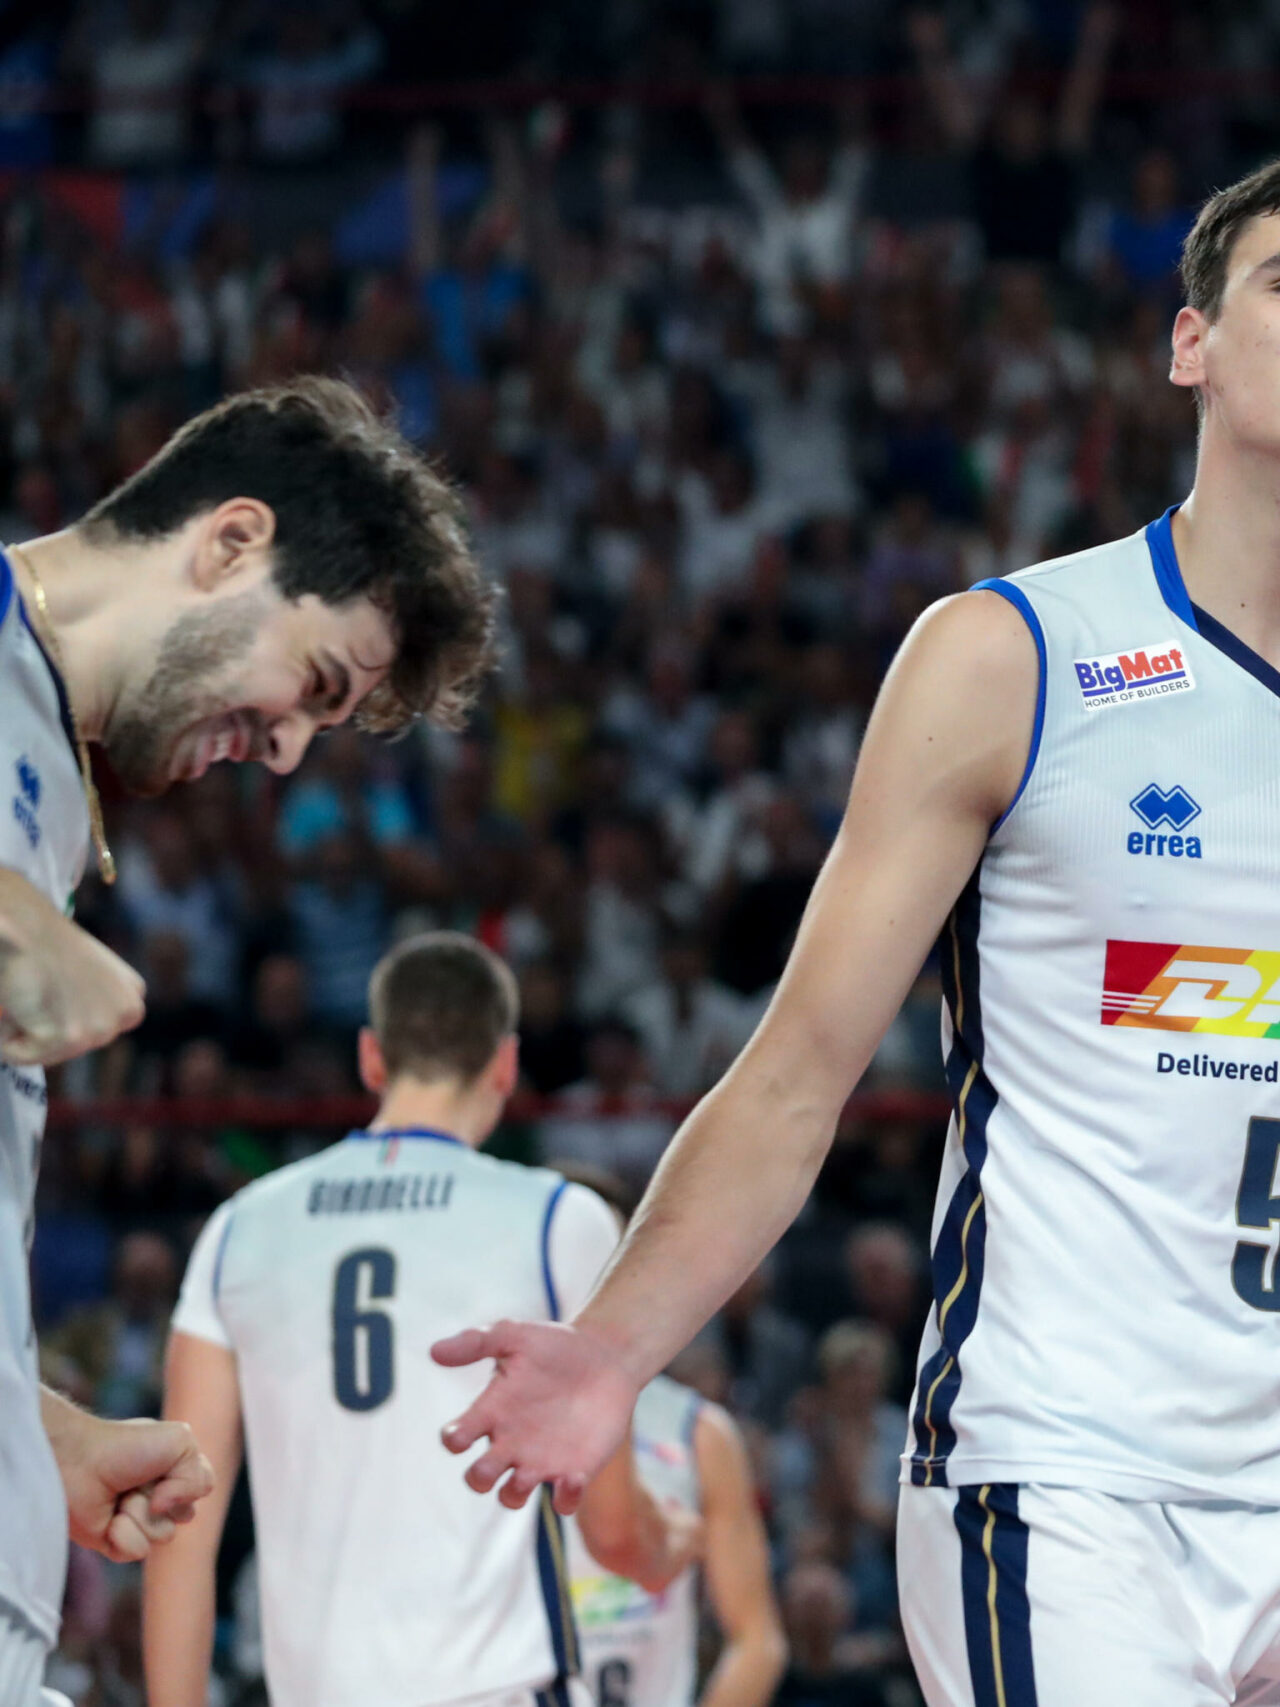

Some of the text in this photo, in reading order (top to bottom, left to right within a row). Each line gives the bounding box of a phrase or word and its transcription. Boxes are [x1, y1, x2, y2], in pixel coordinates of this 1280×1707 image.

[1074, 648, 1184, 692] BigMat
[1084, 680, 1190, 708] HOME OF BUILDERS
[1127, 831, 1202, 859] errea
[1157, 1052, 1279, 1083] Delivered
[331, 1246, 396, 1413] 6
